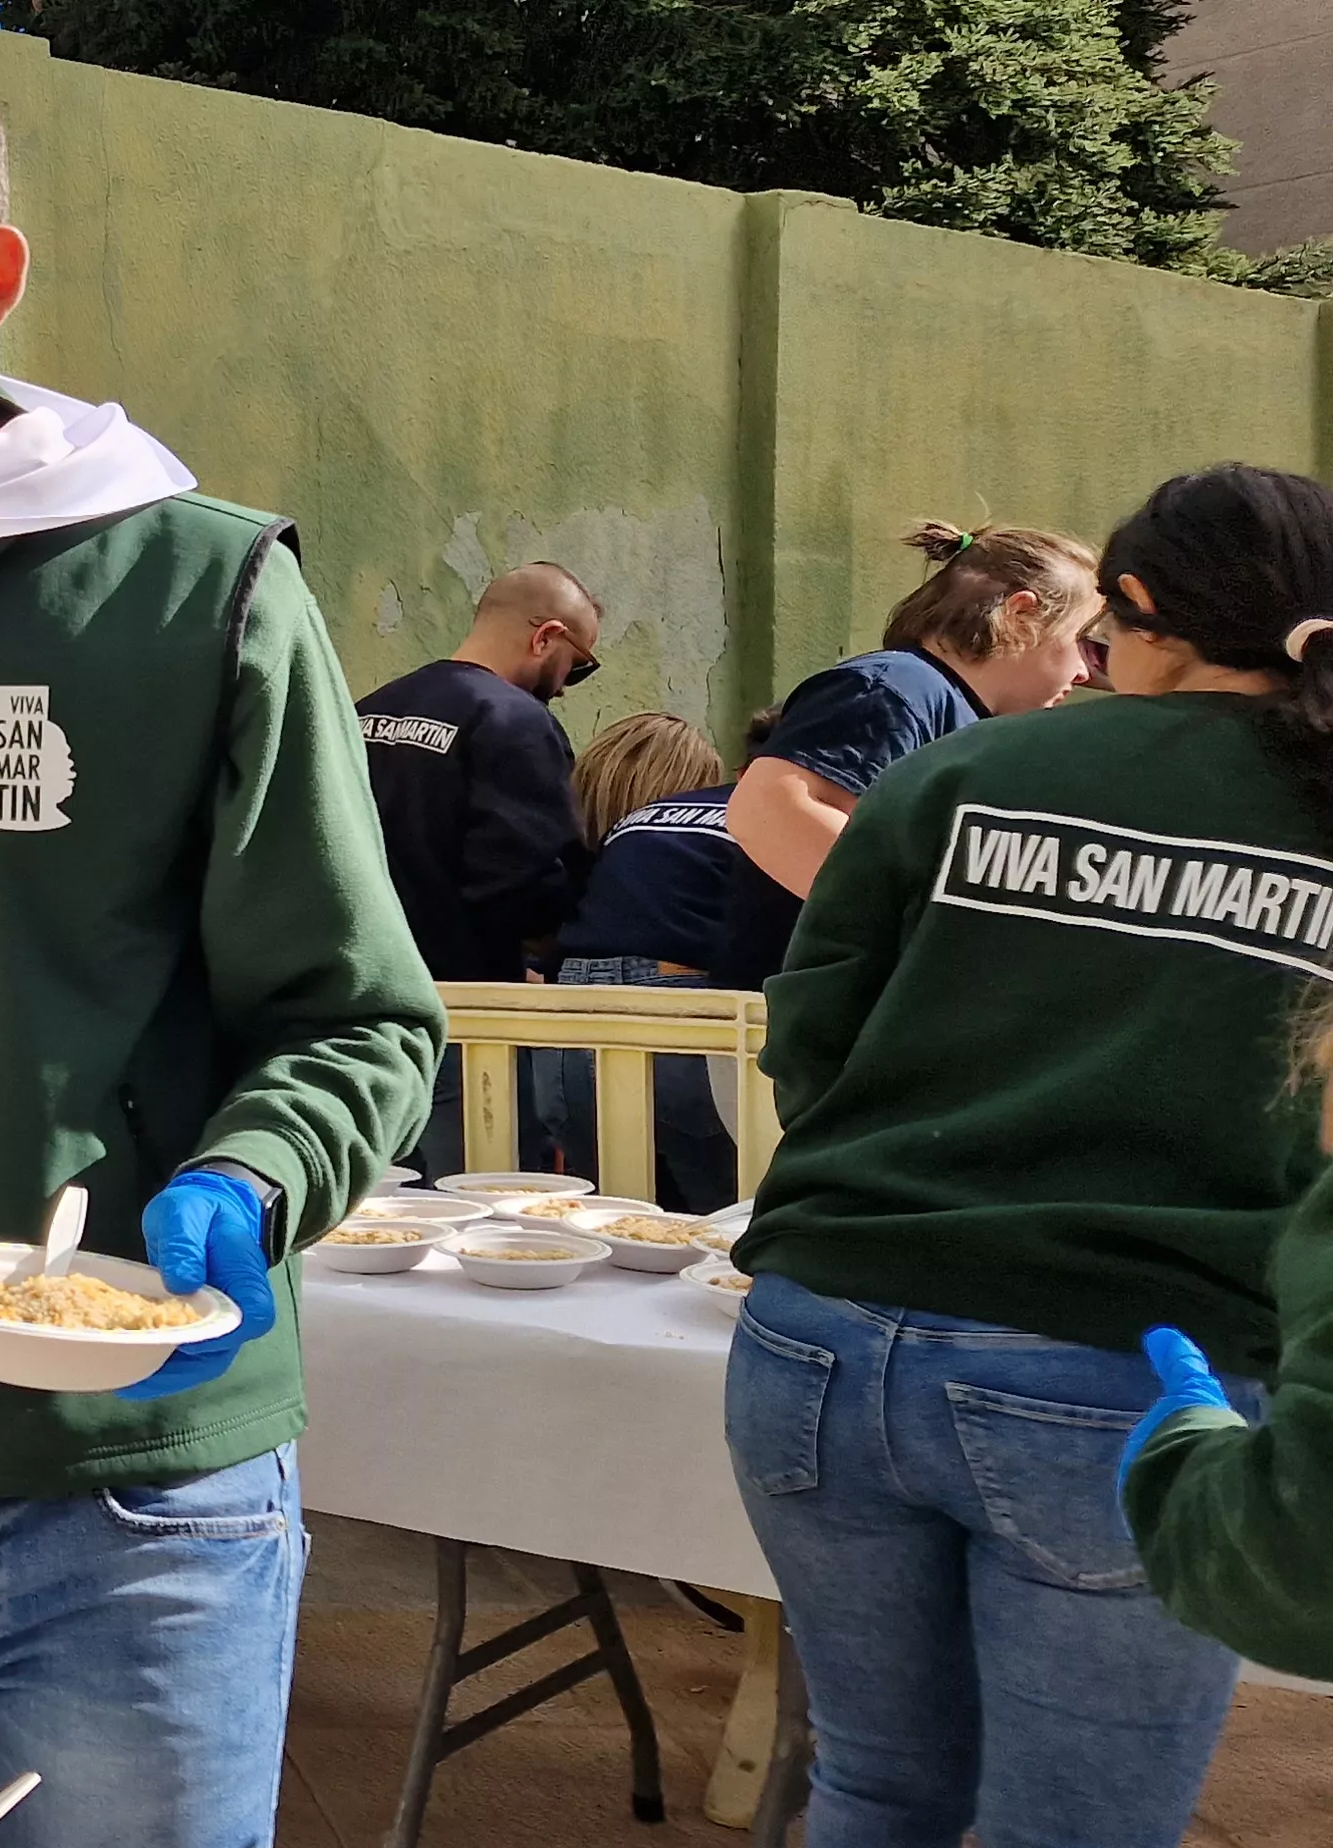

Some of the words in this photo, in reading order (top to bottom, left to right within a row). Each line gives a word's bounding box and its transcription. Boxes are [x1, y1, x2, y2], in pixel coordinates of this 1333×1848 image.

[10, 695, 44, 715] VIVA
[965, 825, 1060, 897] VIVA
[1067, 843, 1173, 914] SAN
